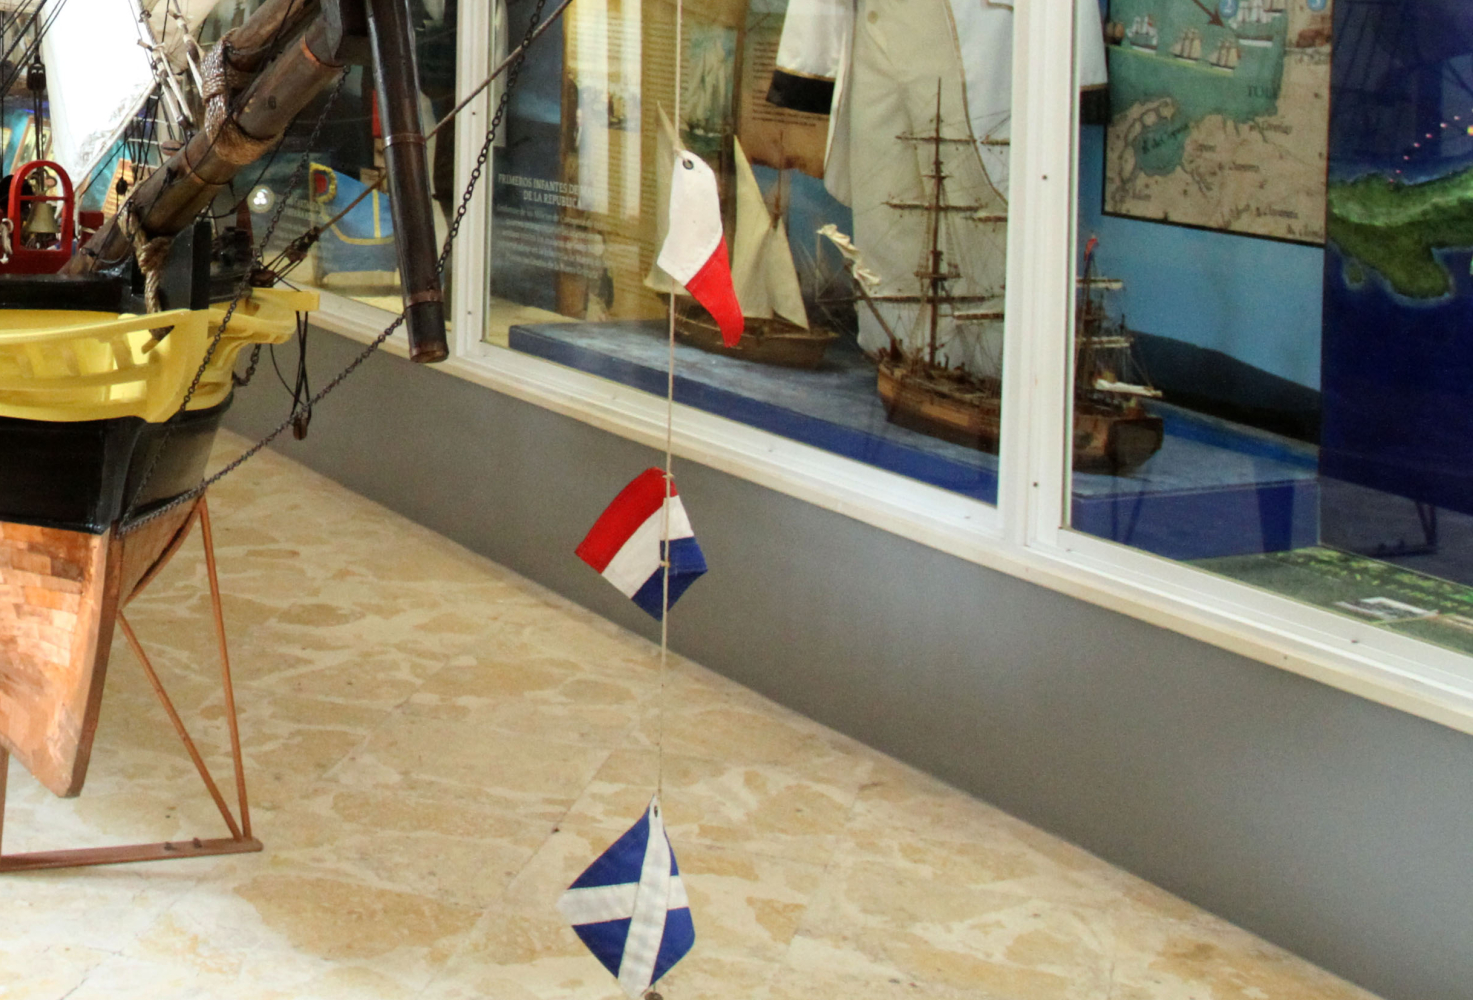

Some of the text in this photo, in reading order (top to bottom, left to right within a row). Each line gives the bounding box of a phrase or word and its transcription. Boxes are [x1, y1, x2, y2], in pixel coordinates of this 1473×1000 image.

[498, 173, 533, 188] PRIMEROS
[533, 178, 568, 194] INFANTES
[523, 190, 533, 201] DE
[534, 192, 543, 202] LA
